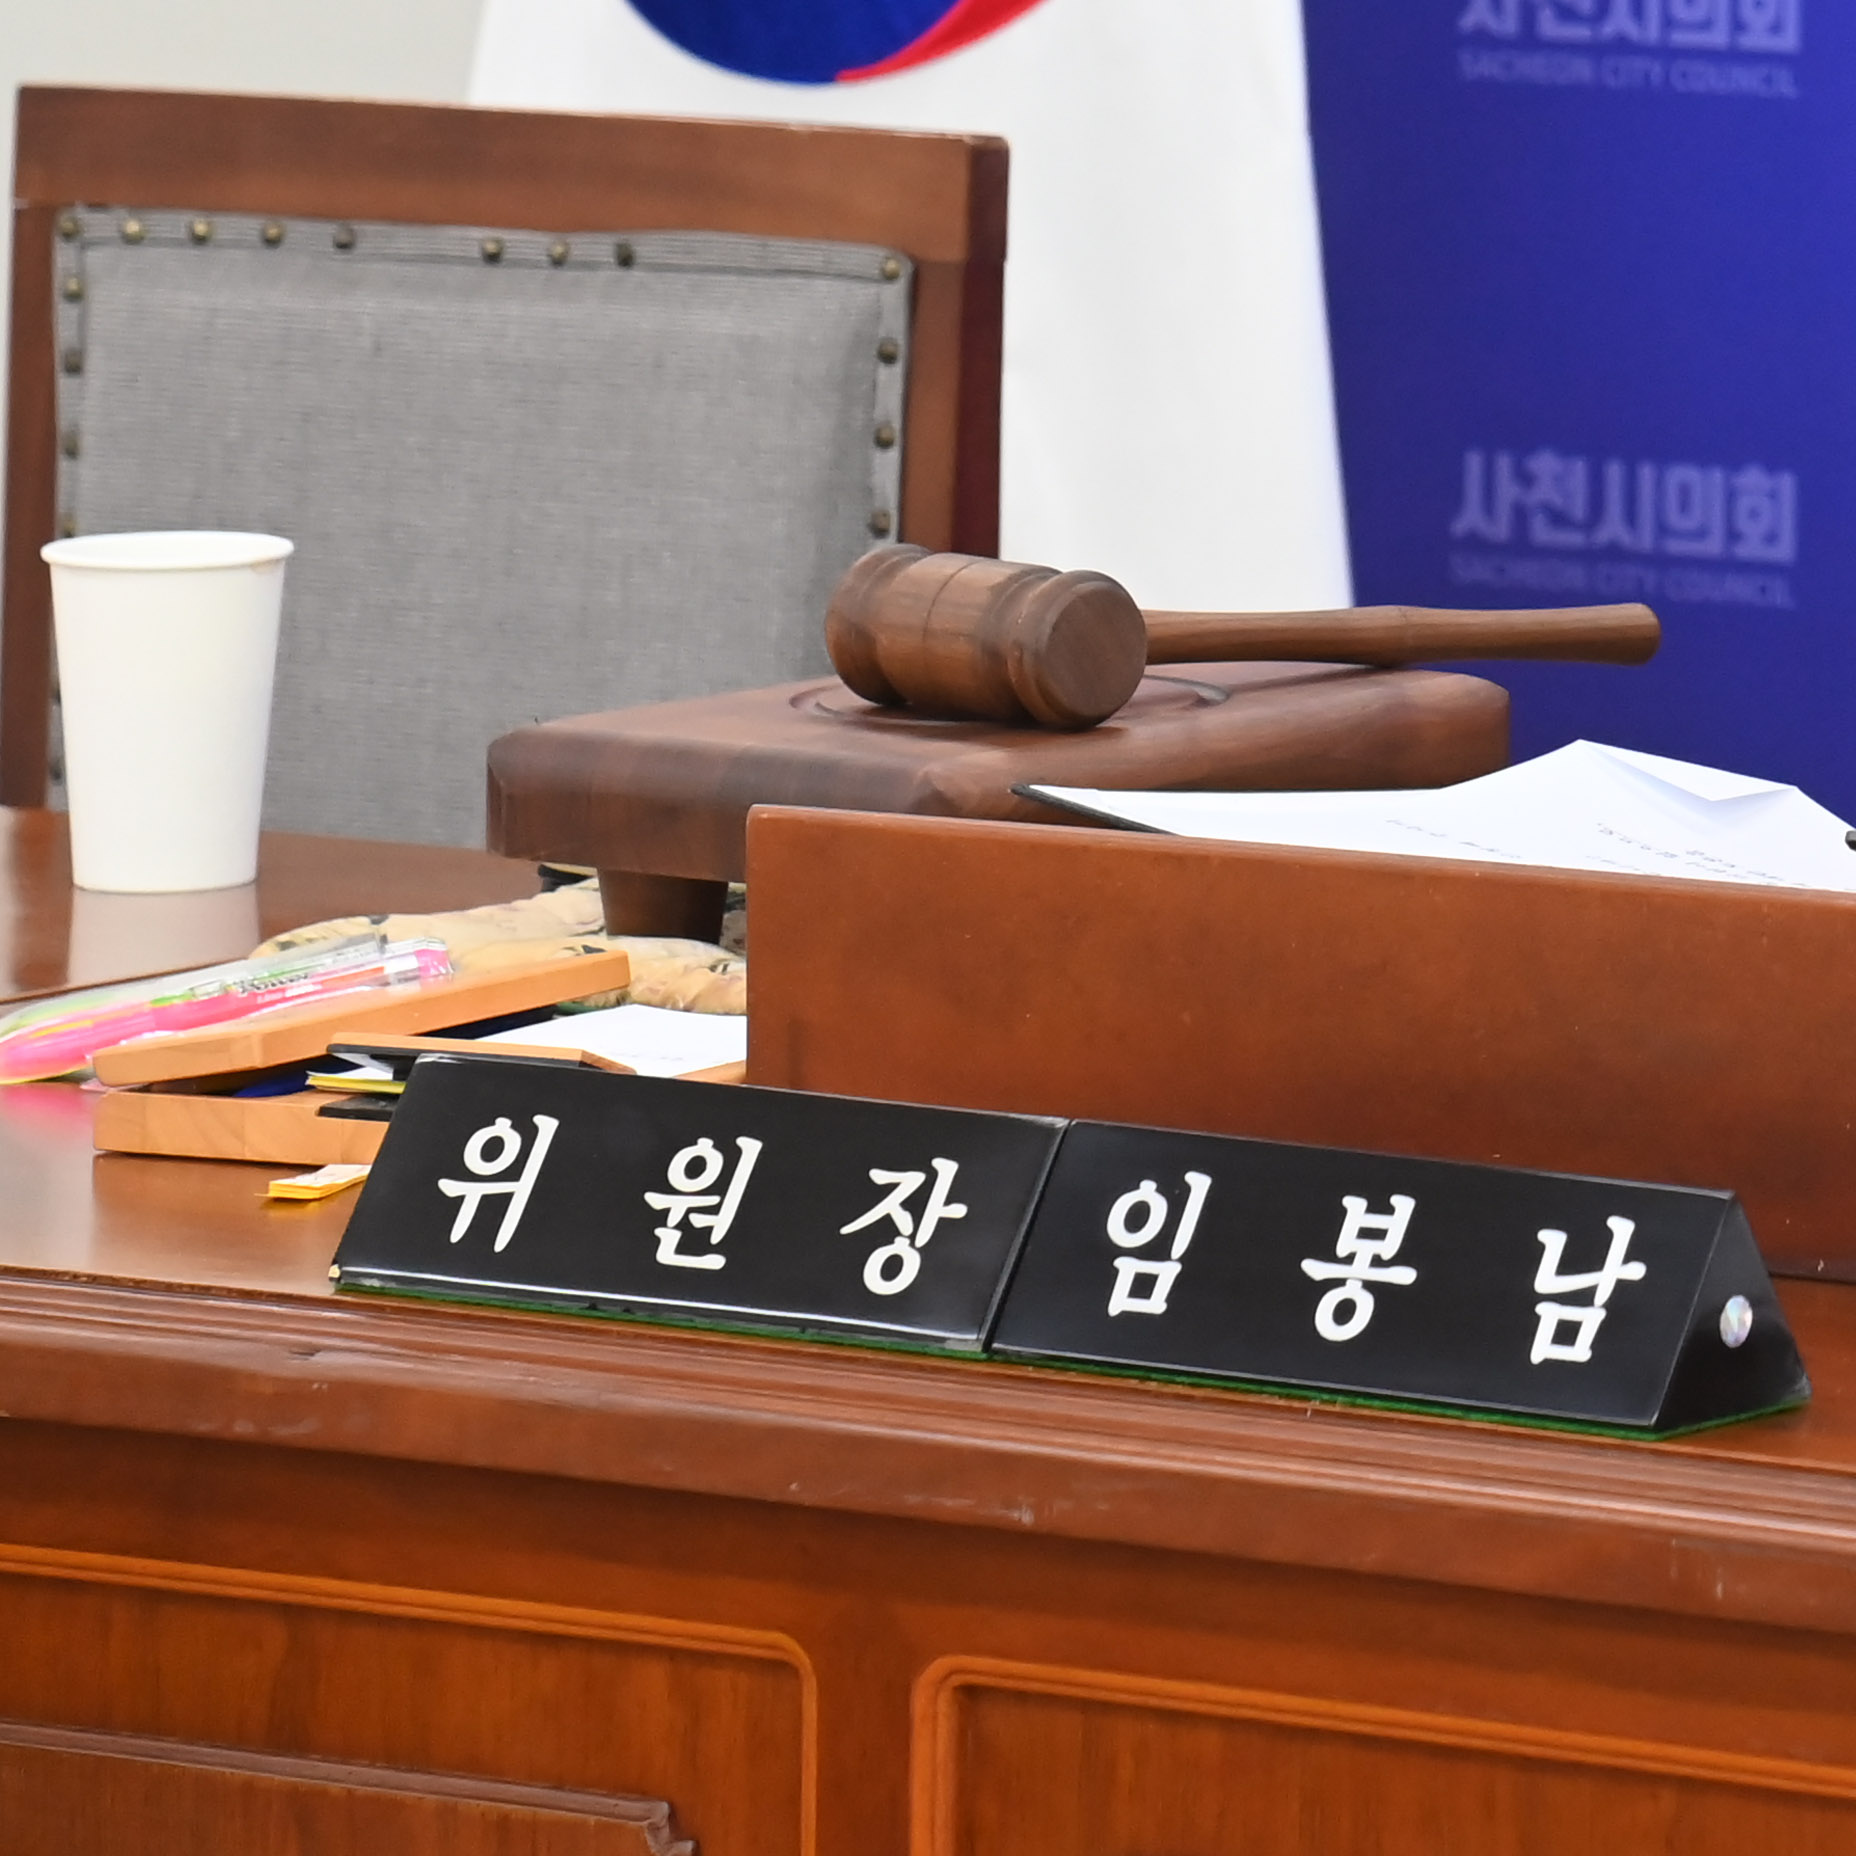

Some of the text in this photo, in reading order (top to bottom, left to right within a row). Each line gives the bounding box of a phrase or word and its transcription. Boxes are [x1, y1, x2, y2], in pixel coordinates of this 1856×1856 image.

[1451, 450, 1796, 563] 사천시의회
[437, 1113, 968, 1296] 위원장
[1107, 1171, 1646, 1364] 임봉남
